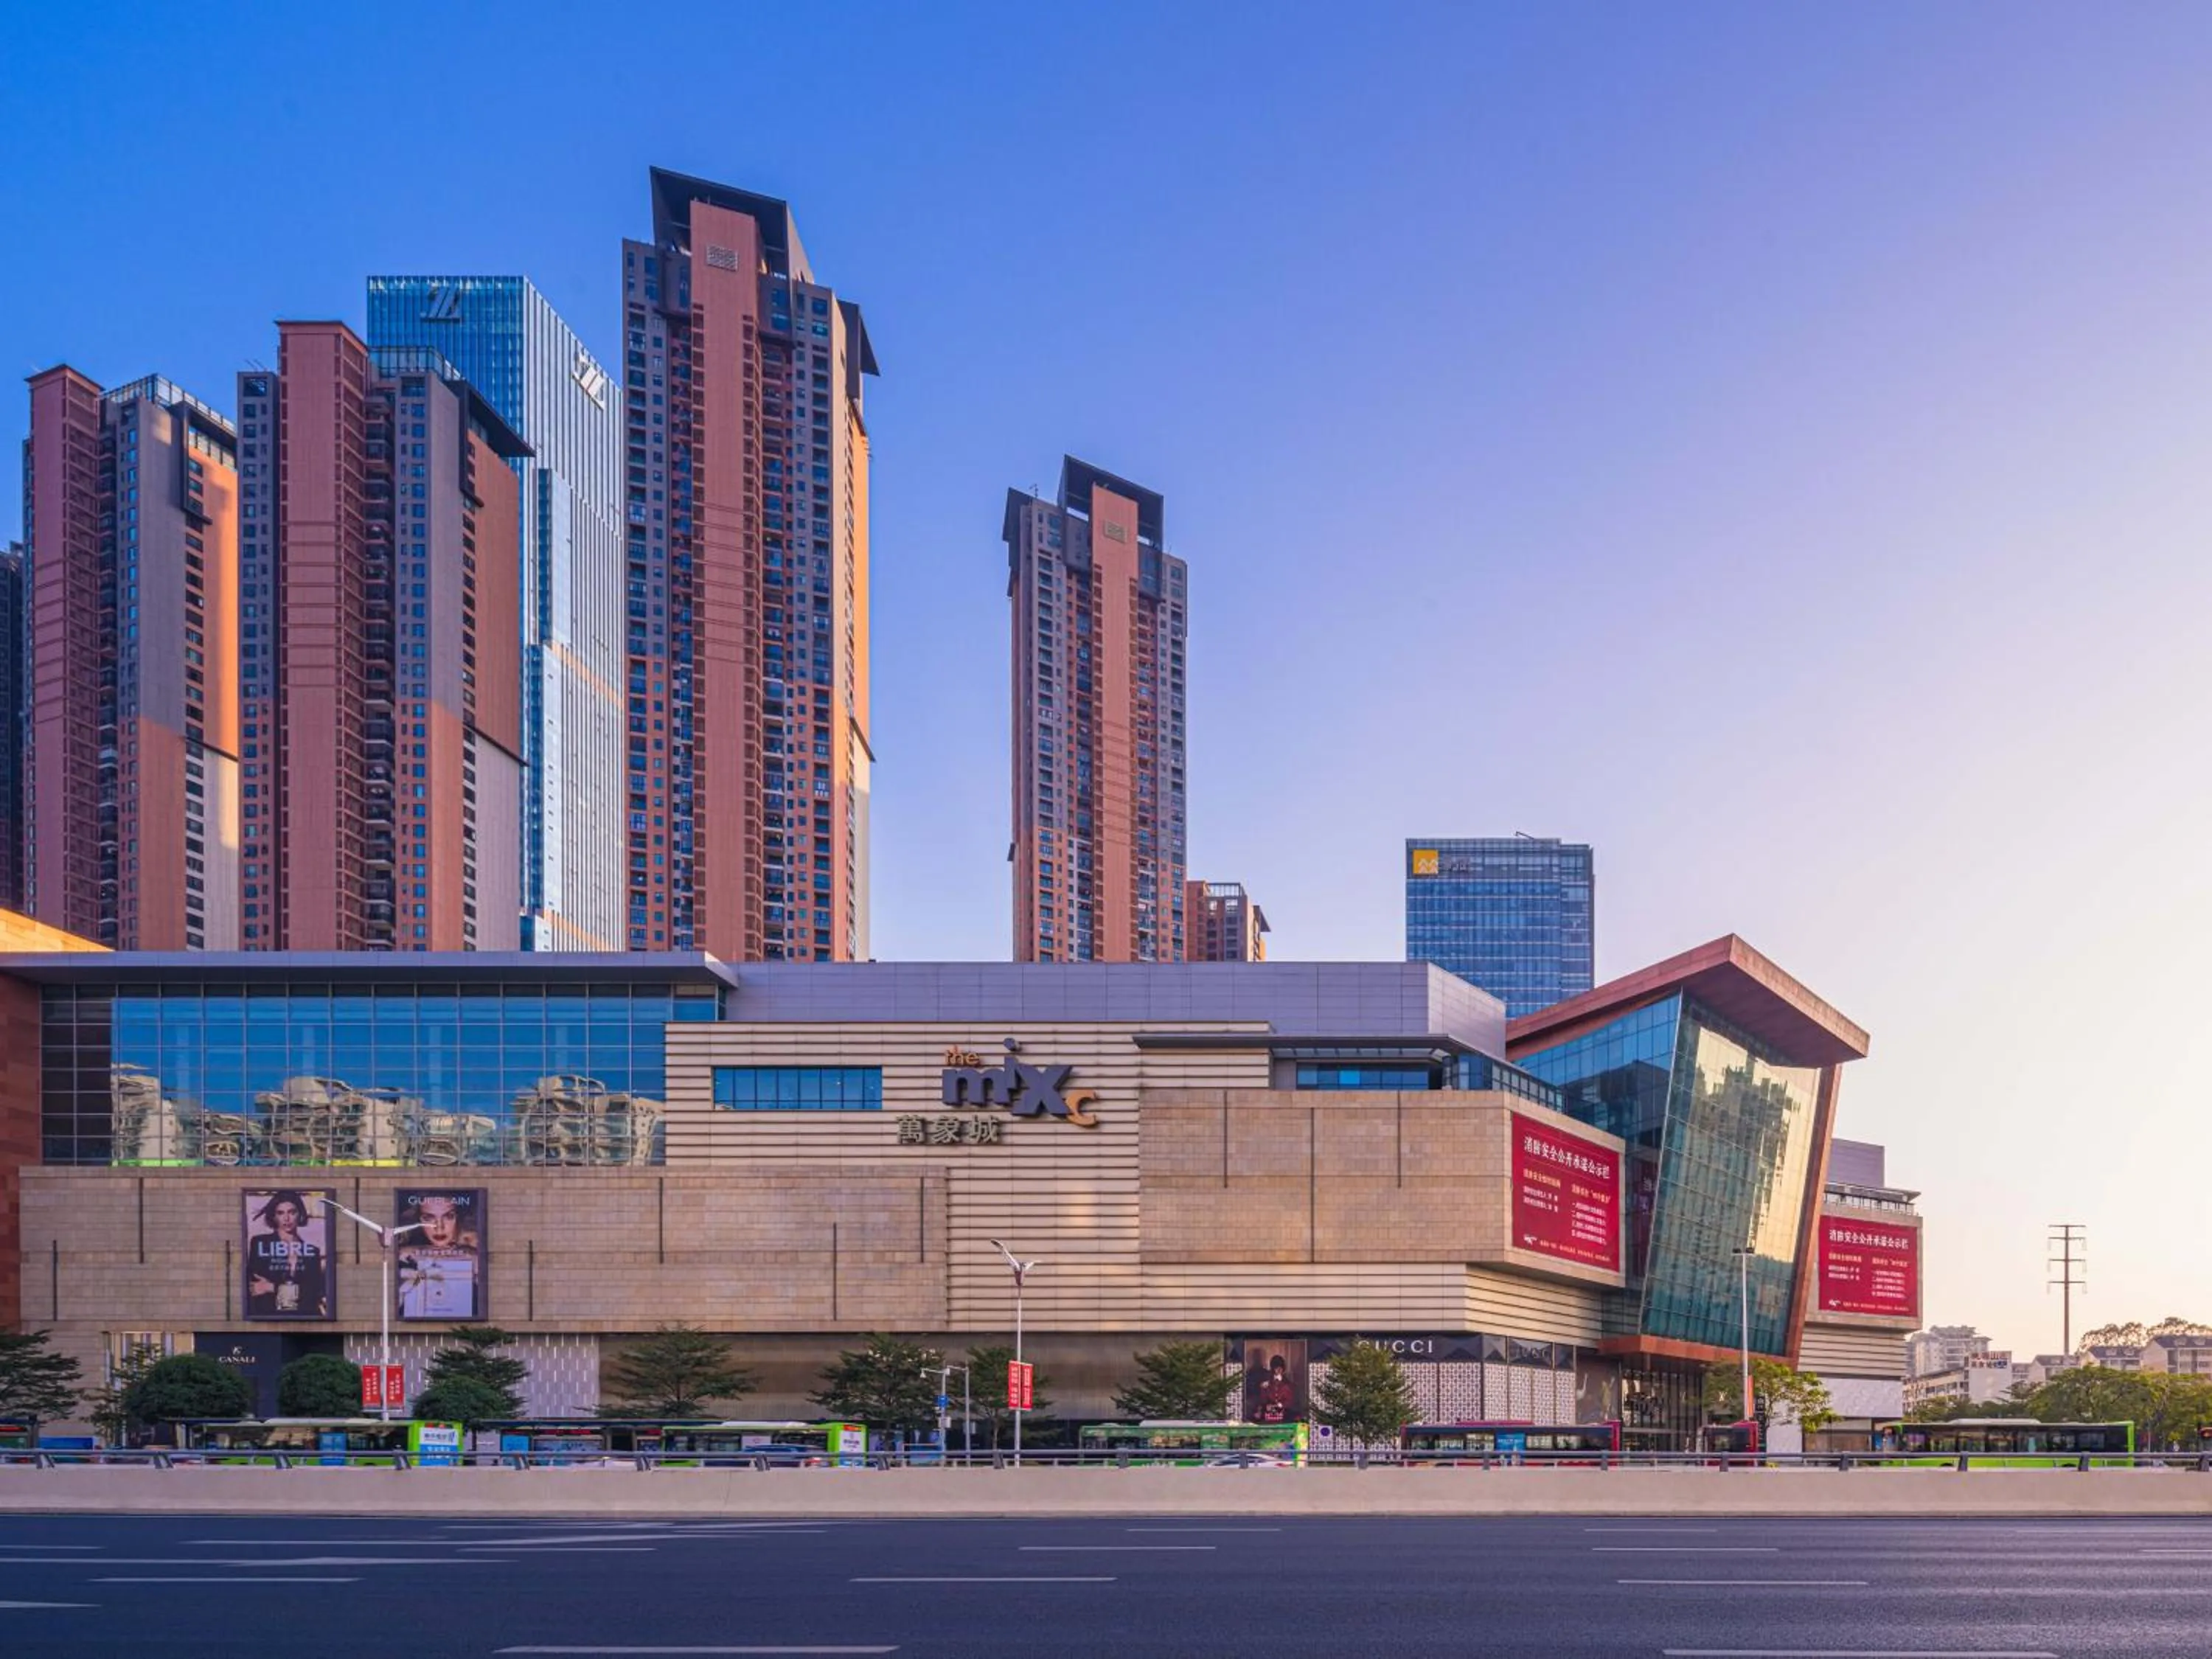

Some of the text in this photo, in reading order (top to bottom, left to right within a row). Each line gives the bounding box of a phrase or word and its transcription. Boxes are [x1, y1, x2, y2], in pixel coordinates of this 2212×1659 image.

[945, 1046, 980, 1065] the
[896, 1115, 1000, 1144] 萬象城
[408, 1196, 470, 1205] GUERLAIN
[258, 1242, 315, 1256] LIBRE
